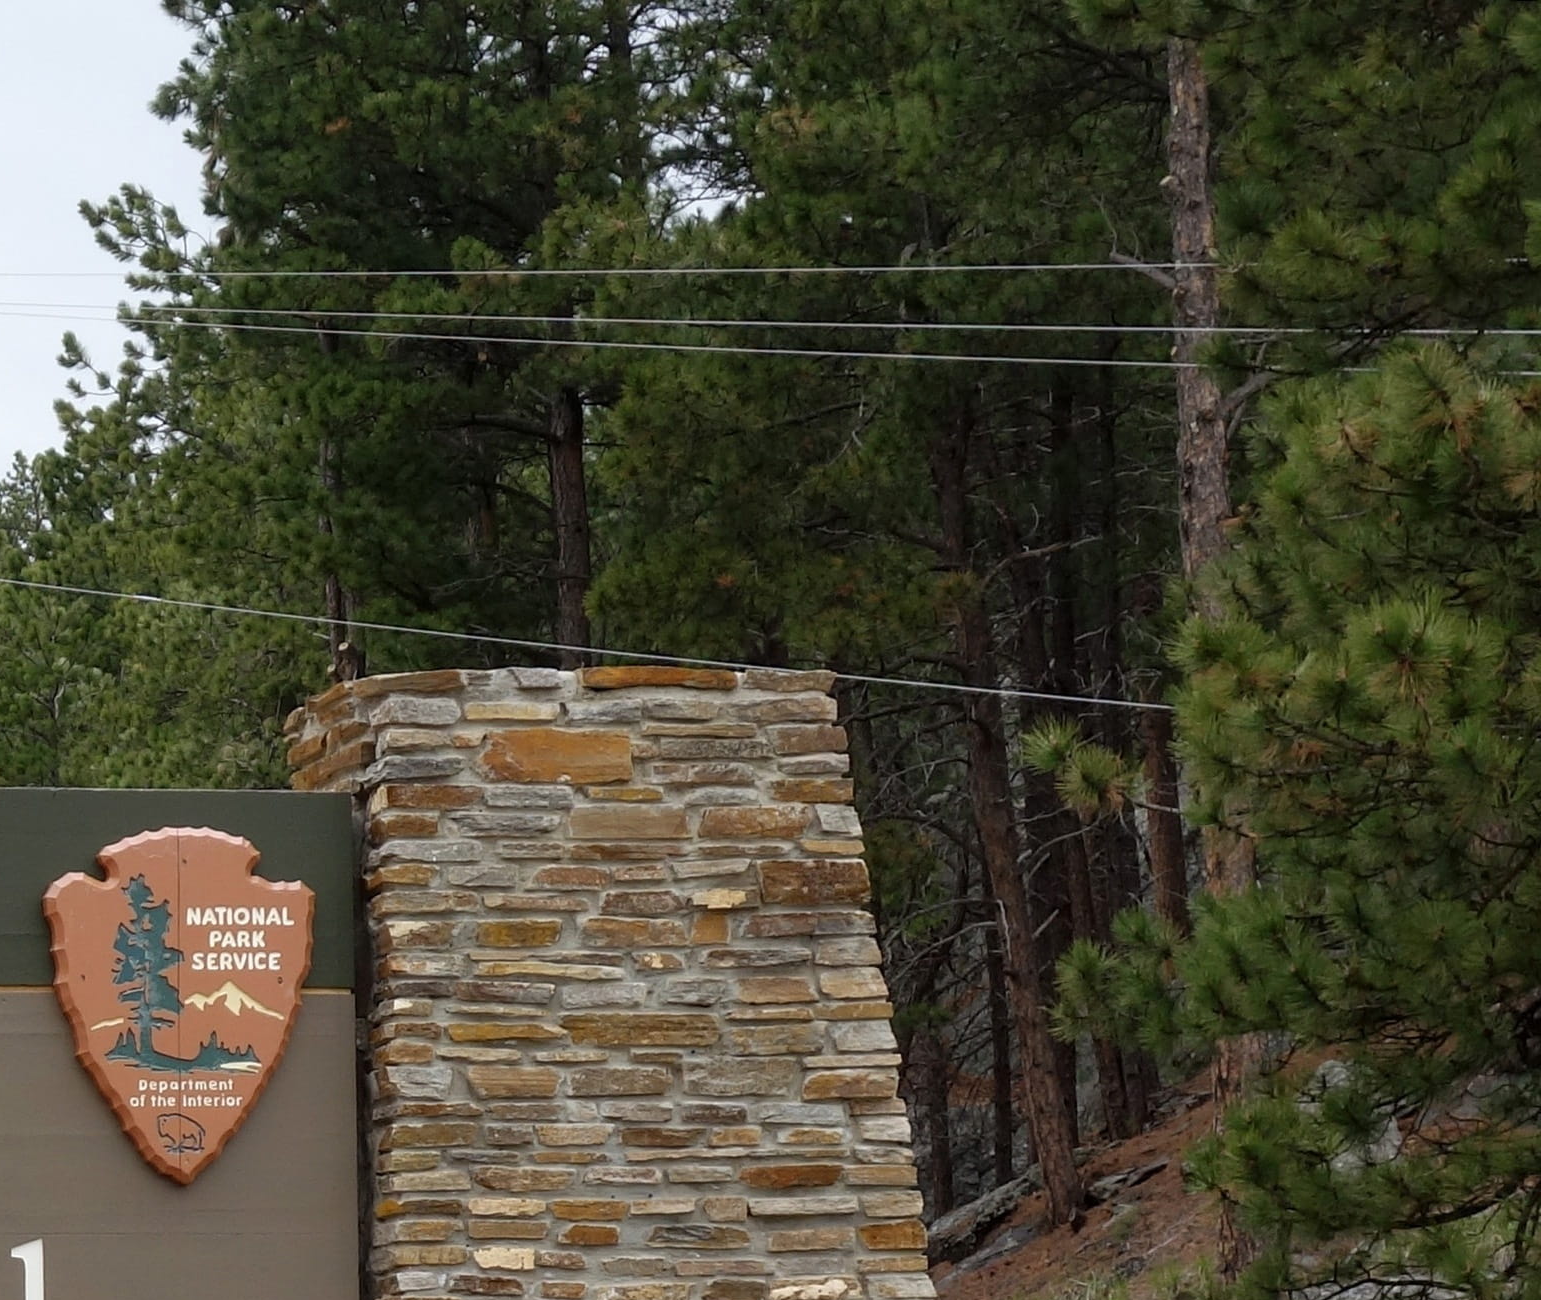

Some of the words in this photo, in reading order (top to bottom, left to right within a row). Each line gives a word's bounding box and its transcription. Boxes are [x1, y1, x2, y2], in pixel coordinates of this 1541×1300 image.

[186, 906, 295, 926] NATIONAL
[209, 930, 266, 948] PARK
[191, 951, 281, 971] SERVICE
[138, 1078, 234, 1093] Department
[129, 1094, 146, 1107] of
[150, 1095, 176, 1107] the
[182, 1094, 243, 1107] Interior
